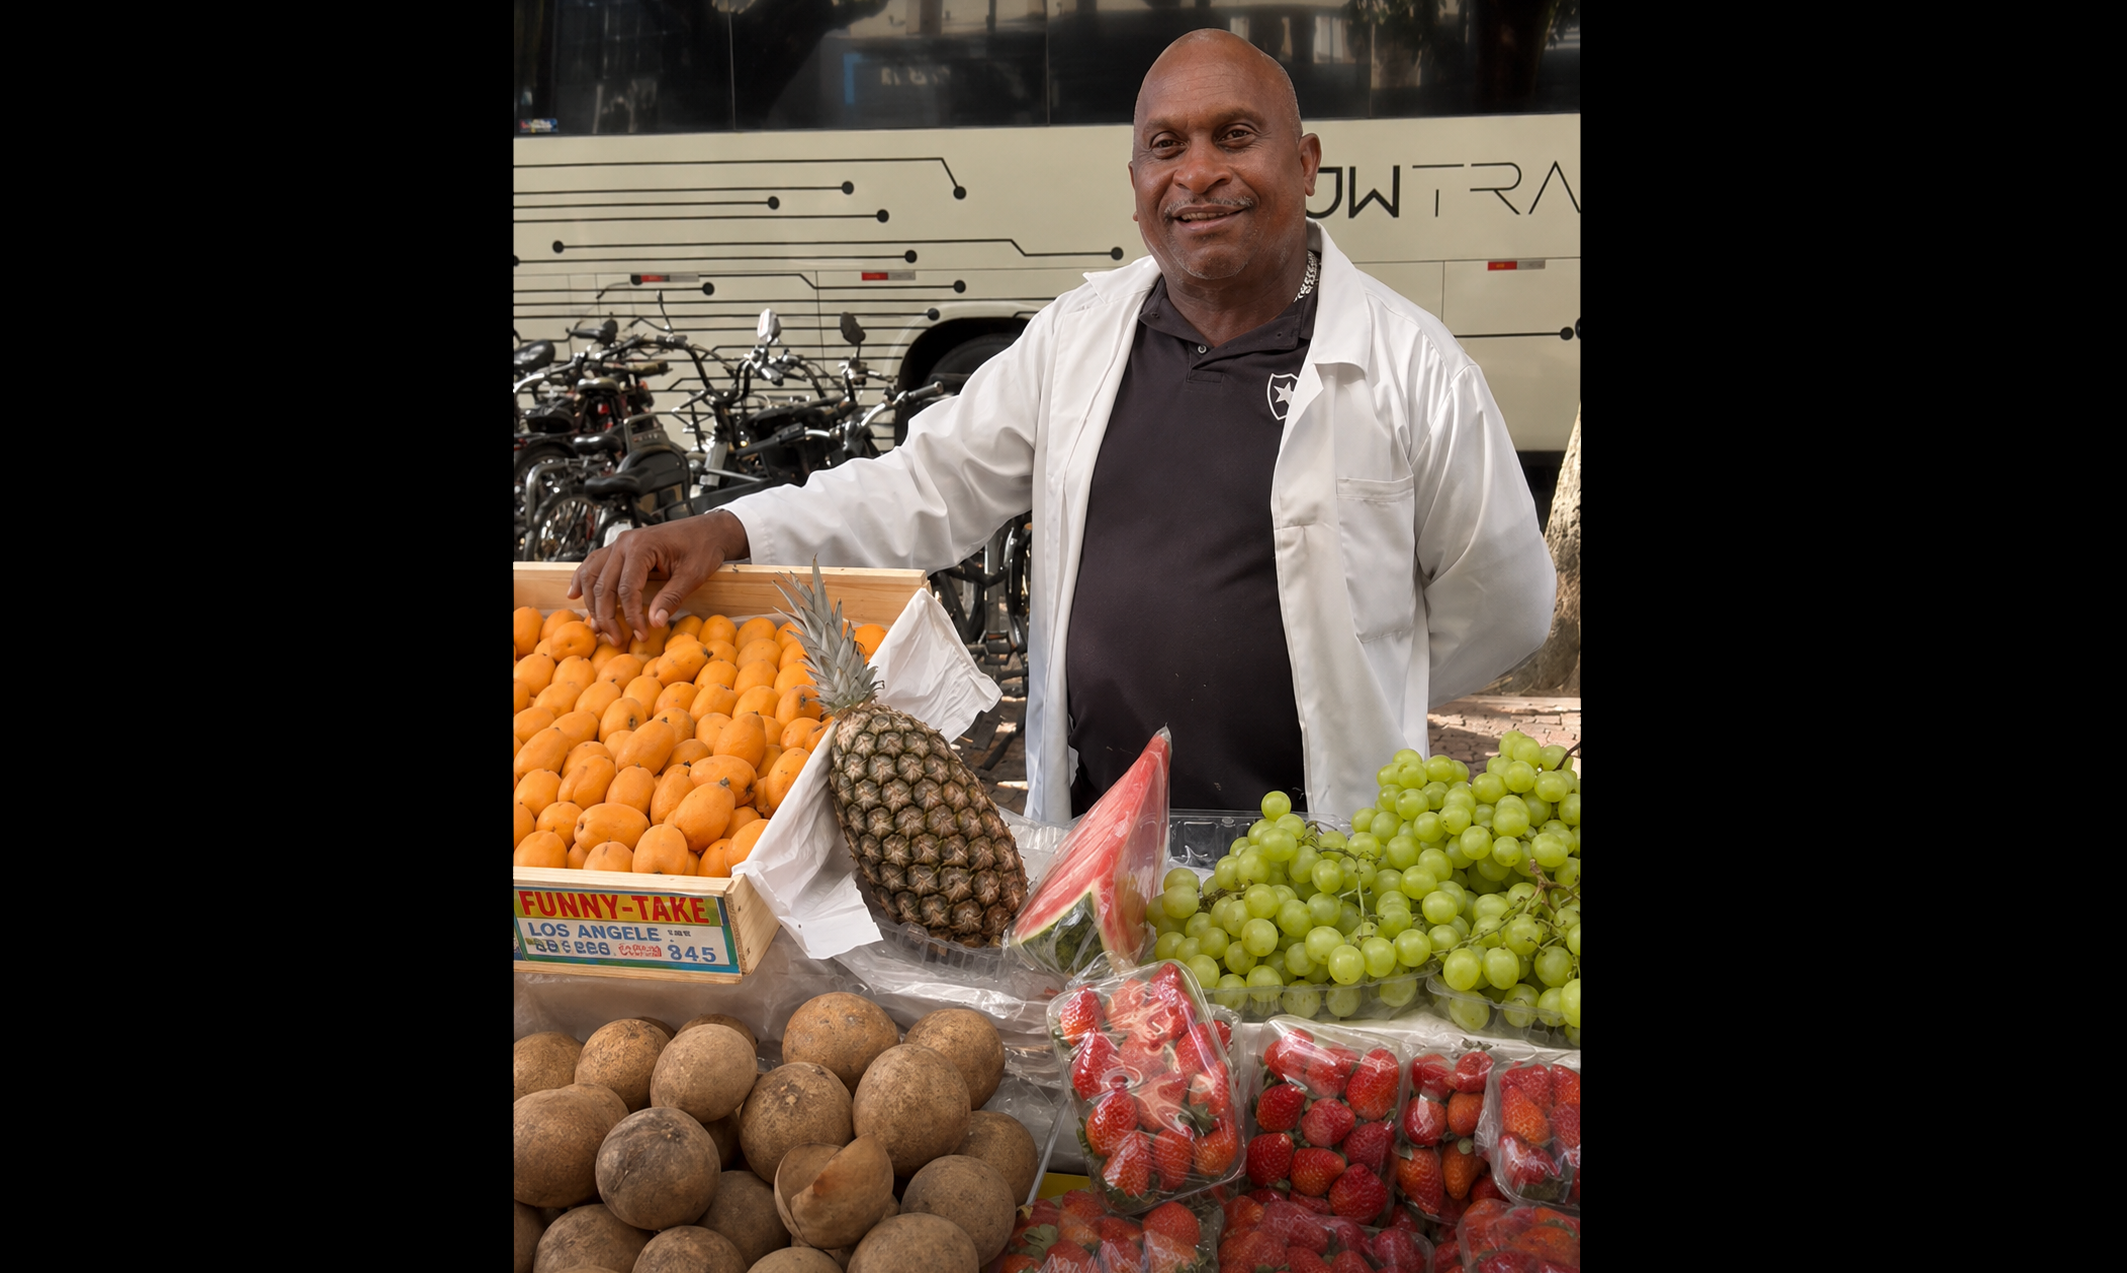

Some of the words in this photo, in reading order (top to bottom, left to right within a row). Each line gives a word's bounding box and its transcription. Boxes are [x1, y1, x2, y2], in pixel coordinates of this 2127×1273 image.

[1306, 165, 1400, 219] JW
[1412, 160, 1581, 218] TRA
[518, 890, 710, 924] FUNNY-TAKE
[528, 922, 570, 937] LOS
[578, 924, 662, 942] ANGELE
[667, 944, 717, 963] 845
